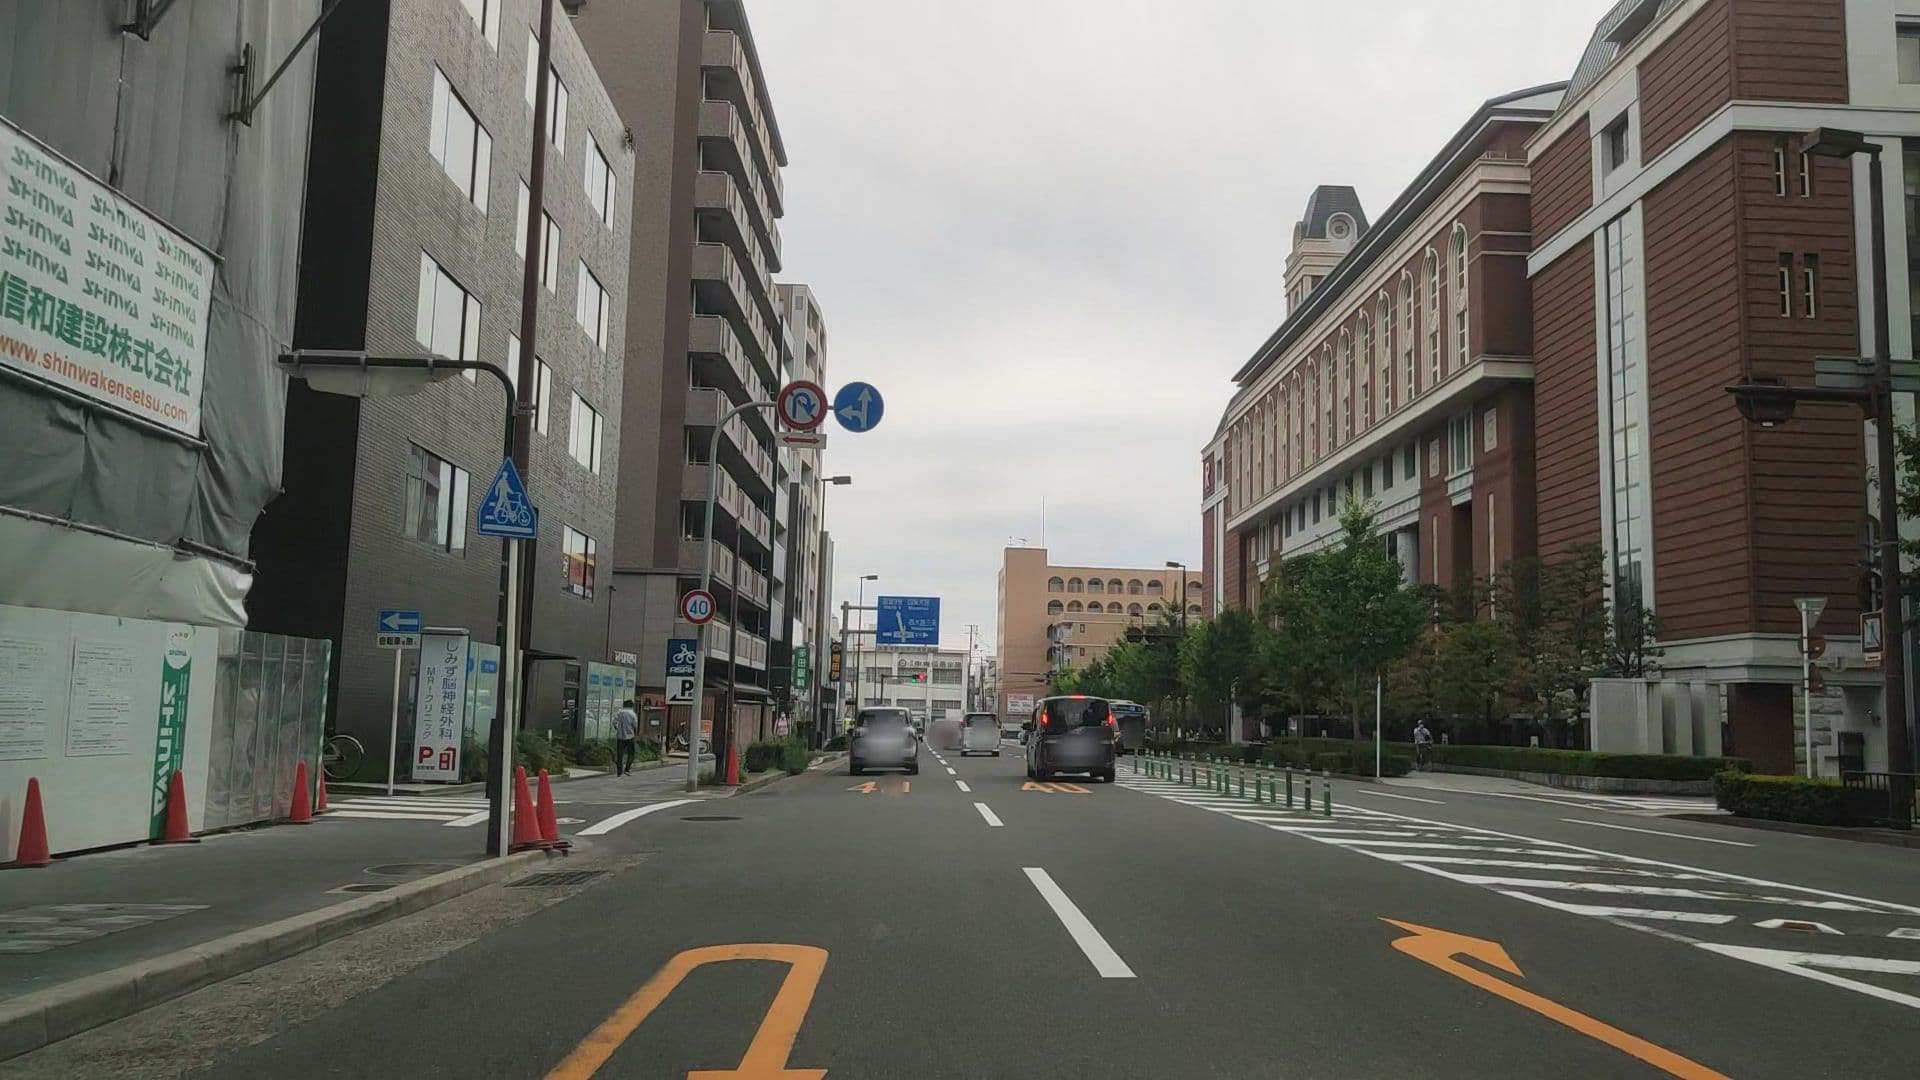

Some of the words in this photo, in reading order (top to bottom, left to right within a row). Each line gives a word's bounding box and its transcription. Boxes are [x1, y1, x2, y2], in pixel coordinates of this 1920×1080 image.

[0, 270, 192, 396] 信和建設株式会社
[689, 601, 708, 615] 40
[670, 666, 696, 674] ASAH
[439, 640, 458, 740] しみず脳神経外科
[418, 746, 434, 764] P
